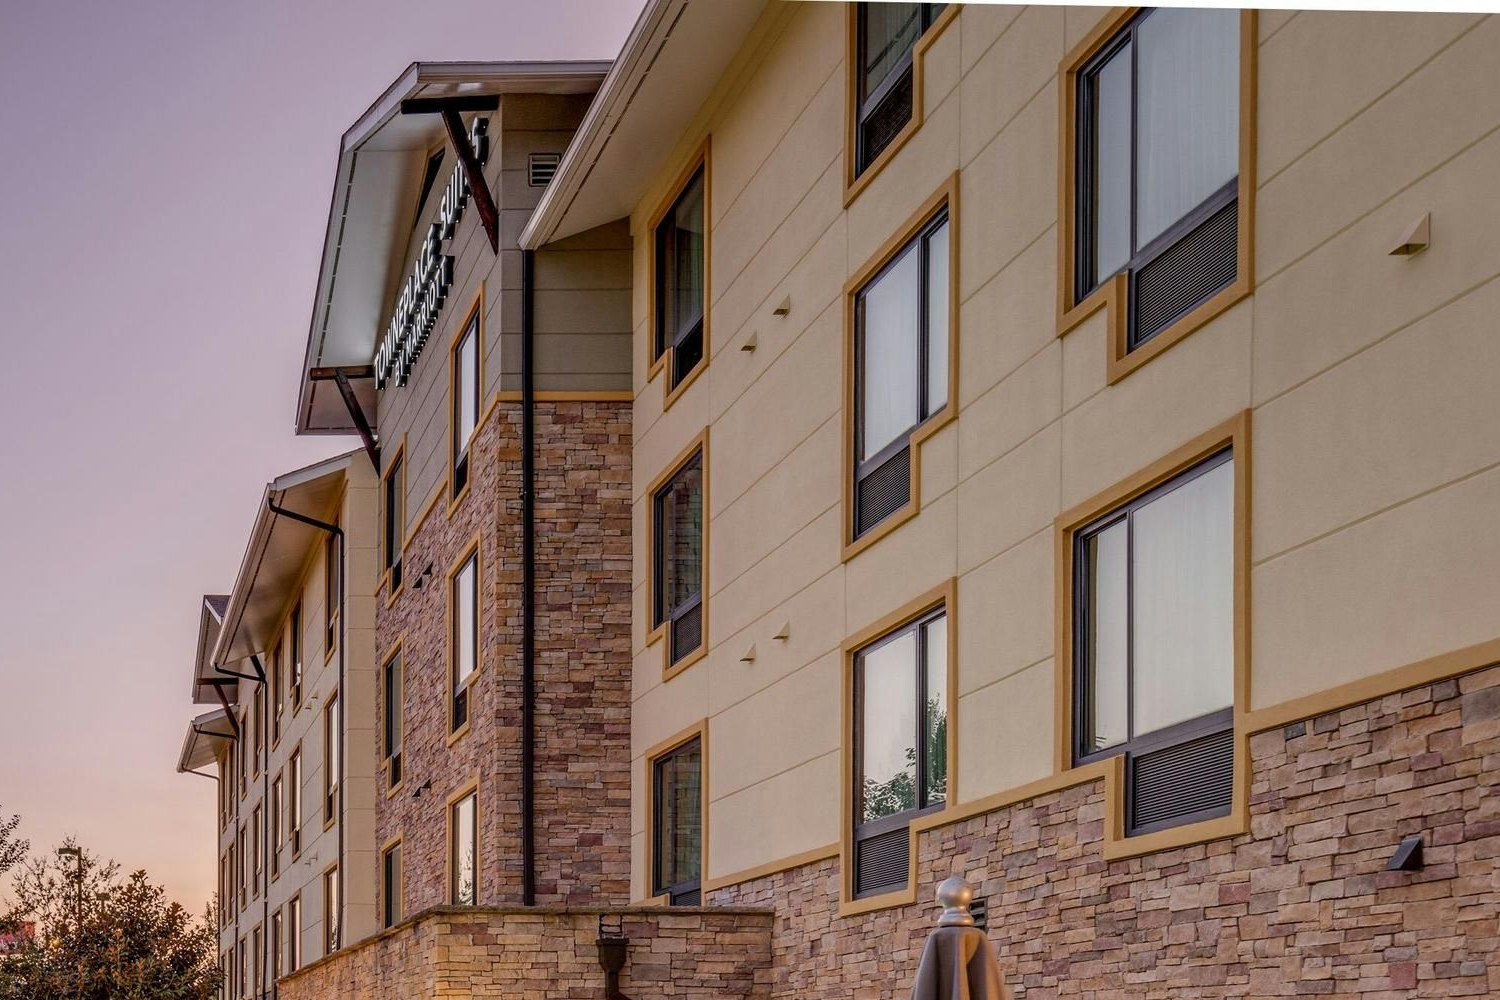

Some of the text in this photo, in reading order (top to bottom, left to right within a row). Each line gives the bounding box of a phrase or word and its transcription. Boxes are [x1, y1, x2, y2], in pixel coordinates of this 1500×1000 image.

[374, 117, 489, 390] TOWNEPLACE SUITS
[405, 256, 455, 365] MARRIOTT
